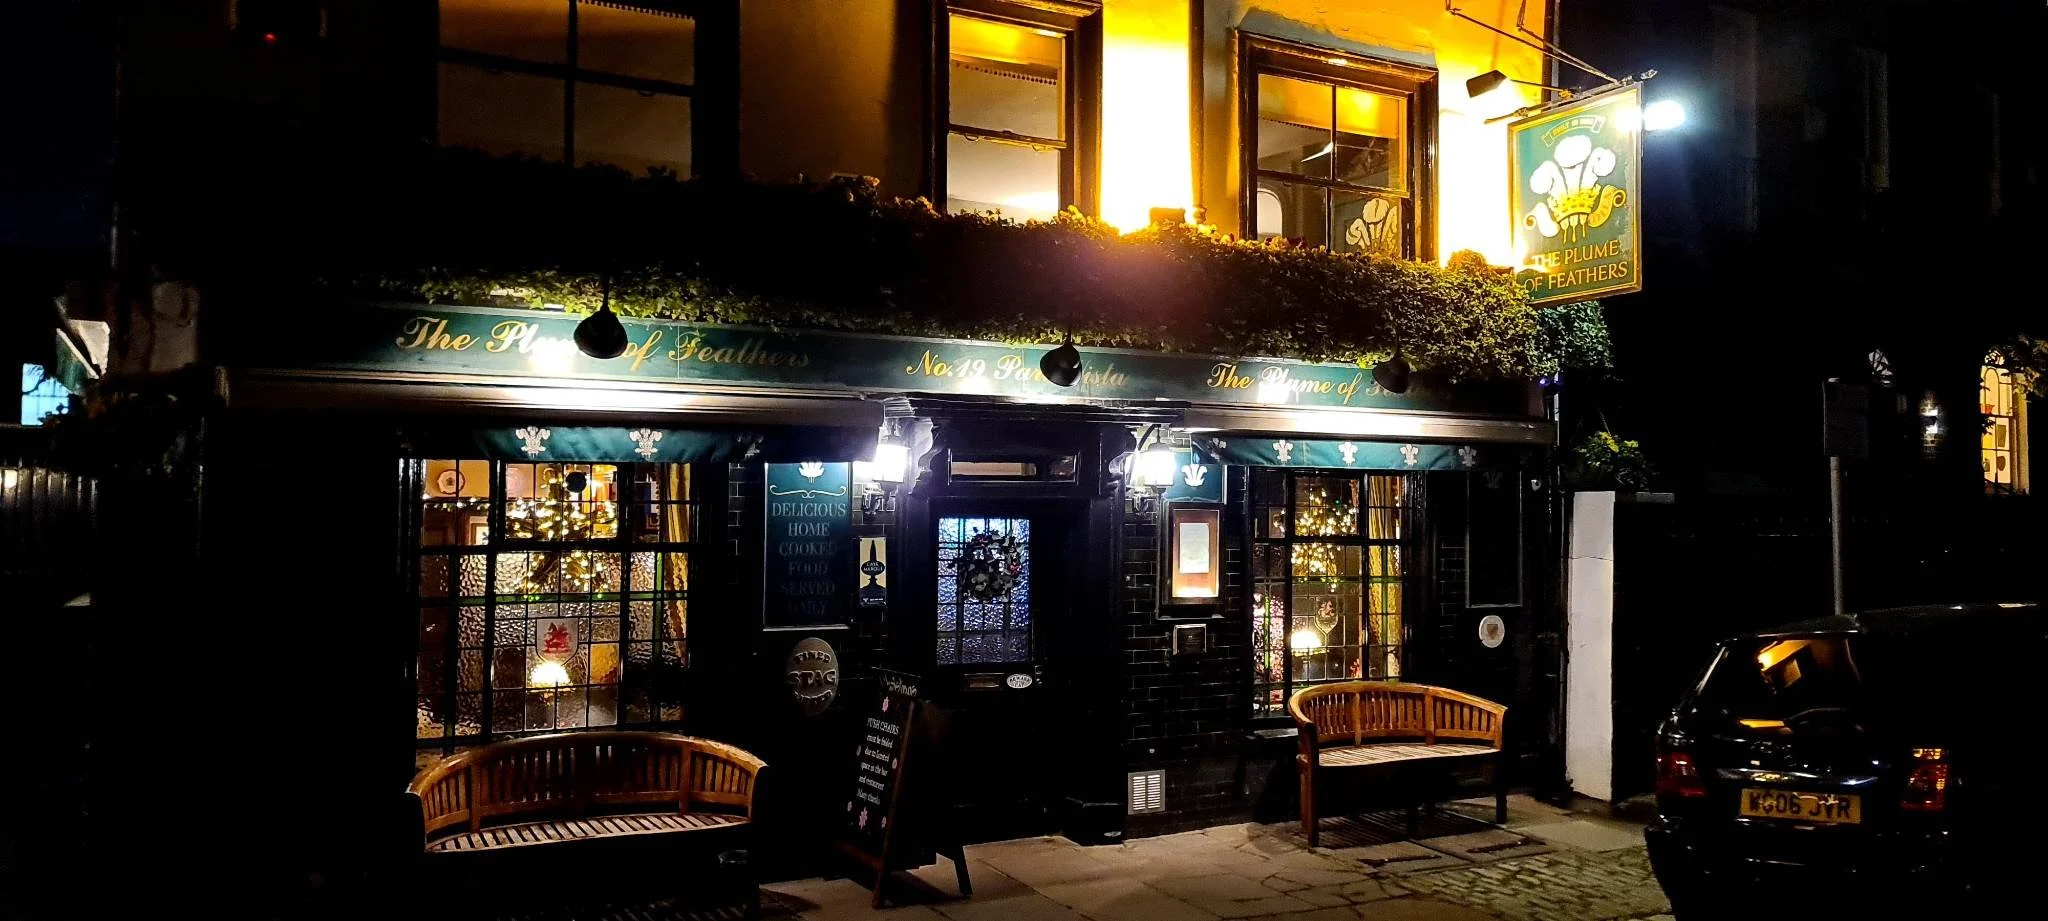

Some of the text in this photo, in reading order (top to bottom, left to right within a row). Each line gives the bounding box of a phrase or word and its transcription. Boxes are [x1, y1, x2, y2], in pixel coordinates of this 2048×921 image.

[1531, 240, 1619, 267] THE PLUME
[1524, 261, 1628, 293] OF FEATHERS
[397, 316, 480, 352] The
[623, 329, 663, 372] of
[669, 329, 812, 369] Feathers
[994, 354, 1046, 383] Par
[1081, 358, 1129, 387] ista
[1207, 362, 1256, 390] The
[1261, 366, 1336, 395] Plume
[1337, 372, 1363, 405] of
[772, 503, 847, 517] DELICIOUS
[788, 522, 830, 536] HOME
[778, 541, 839, 556] COOKED
[788, 561, 828, 576] FOOD
[780, 579, 836, 597] SERVED
[786, 669, 837, 688] STAG
